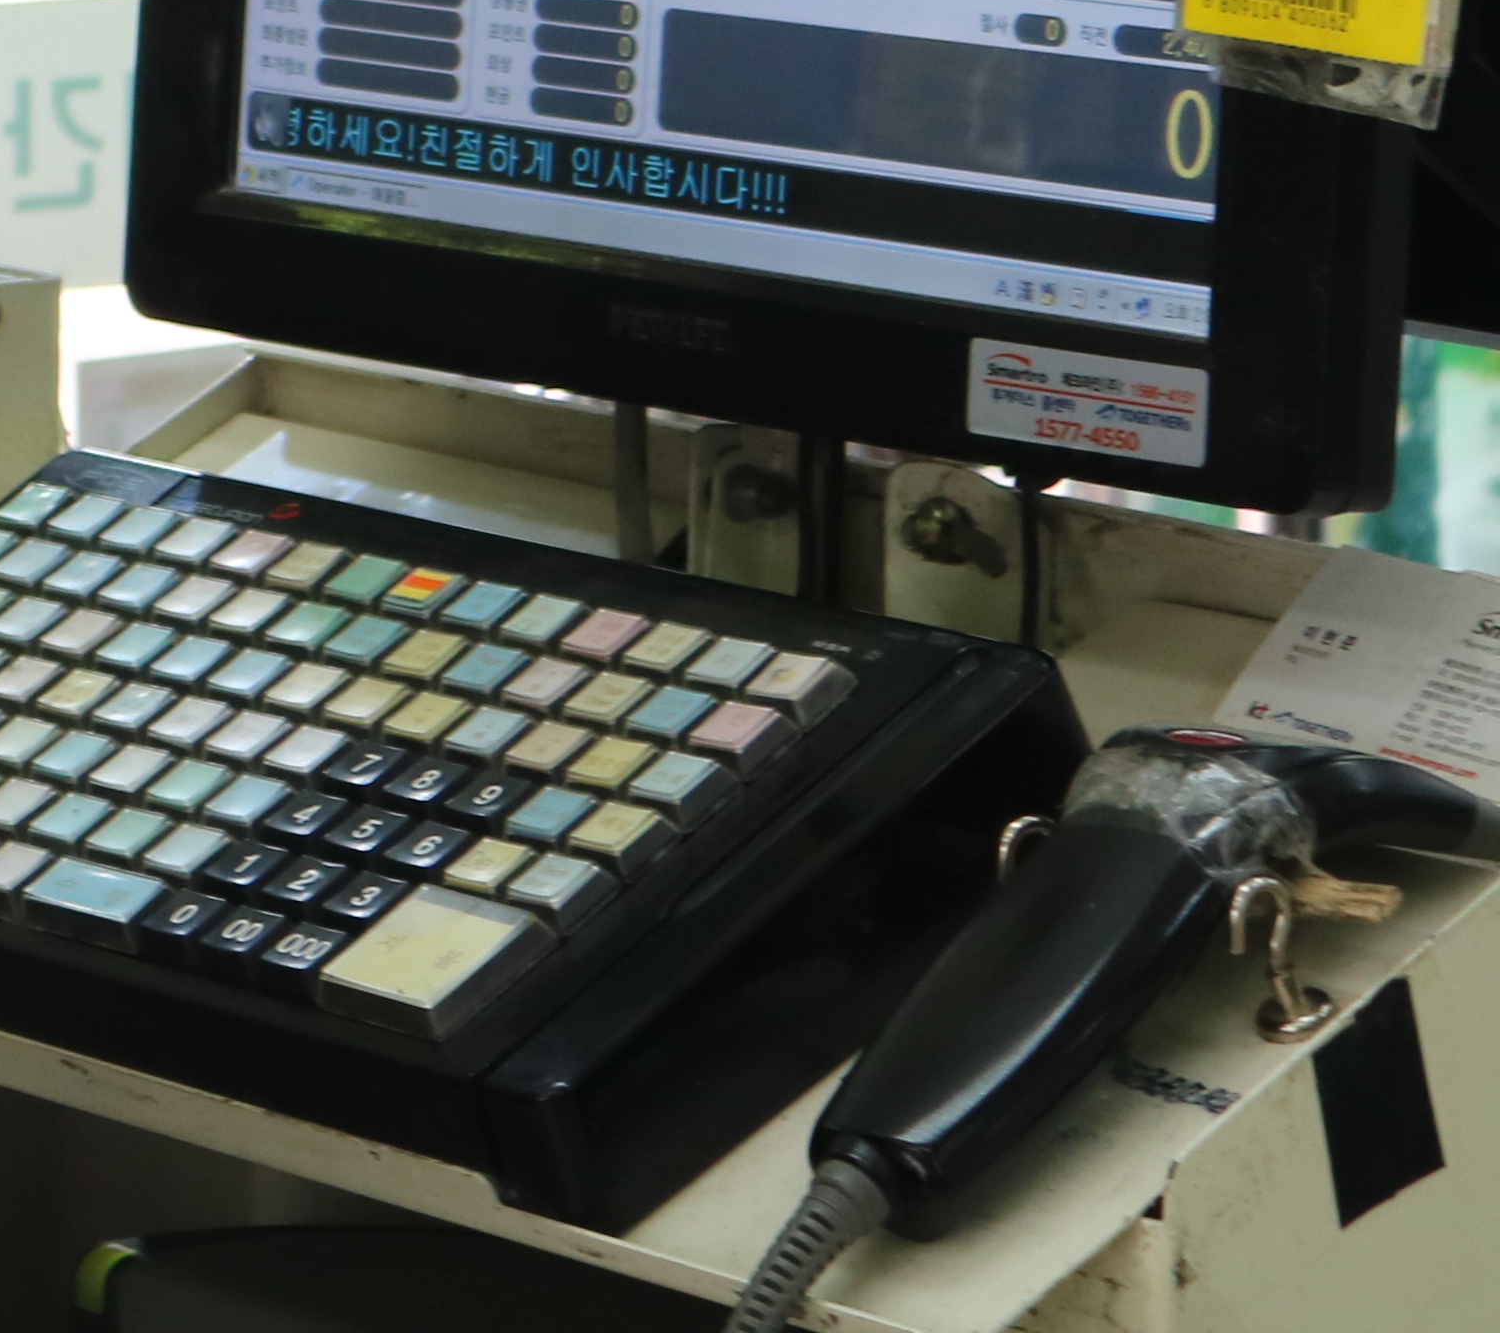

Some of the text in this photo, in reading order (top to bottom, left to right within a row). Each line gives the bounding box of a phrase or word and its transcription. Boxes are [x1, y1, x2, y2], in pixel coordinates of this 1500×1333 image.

[1165, 88, 1214, 180] 0
[571, 144, 787, 215] 인사합시다!!!
[350, 752, 505, 807] 7 8 9
[291, 803, 445, 857] 4 5 6
[232, 852, 384, 909] 1 2 3
[168, 903, 334, 961] 0 00 000
